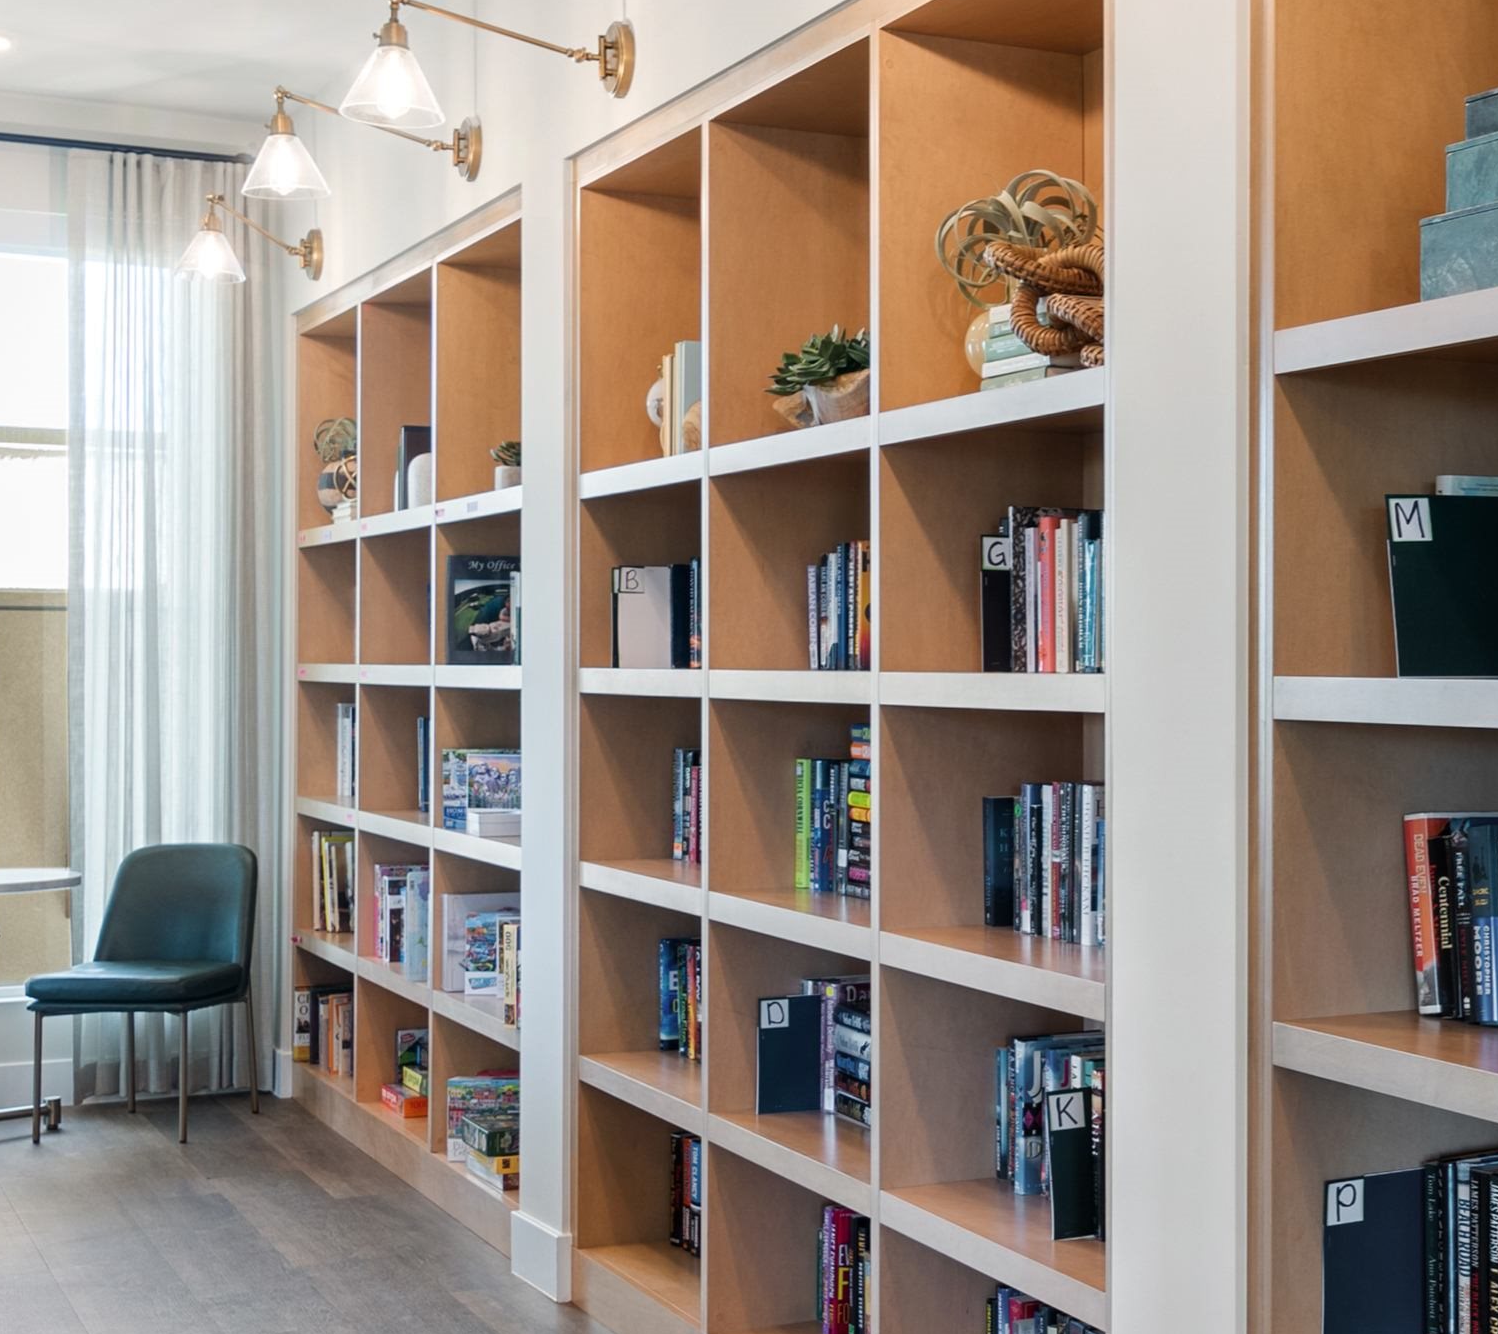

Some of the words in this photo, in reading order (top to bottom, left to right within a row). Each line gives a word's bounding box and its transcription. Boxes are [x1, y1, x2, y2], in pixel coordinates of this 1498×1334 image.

[1395, 500, 1425, 538] M
[487, 560, 516, 572] Office
[988, 543, 1005, 567] G
[625, 571, 638, 590] B
[1438, 876, 1452, 950] Centennial
[1473, 925, 1483, 995] MOORE
[1483, 926, 1492, 996] CHRISTOPHER
[1057, 1098, 1075, 1127] K
[1335, 1183, 1357, 1221] P
[1489, 1279, 1498, 1313] ALEX
